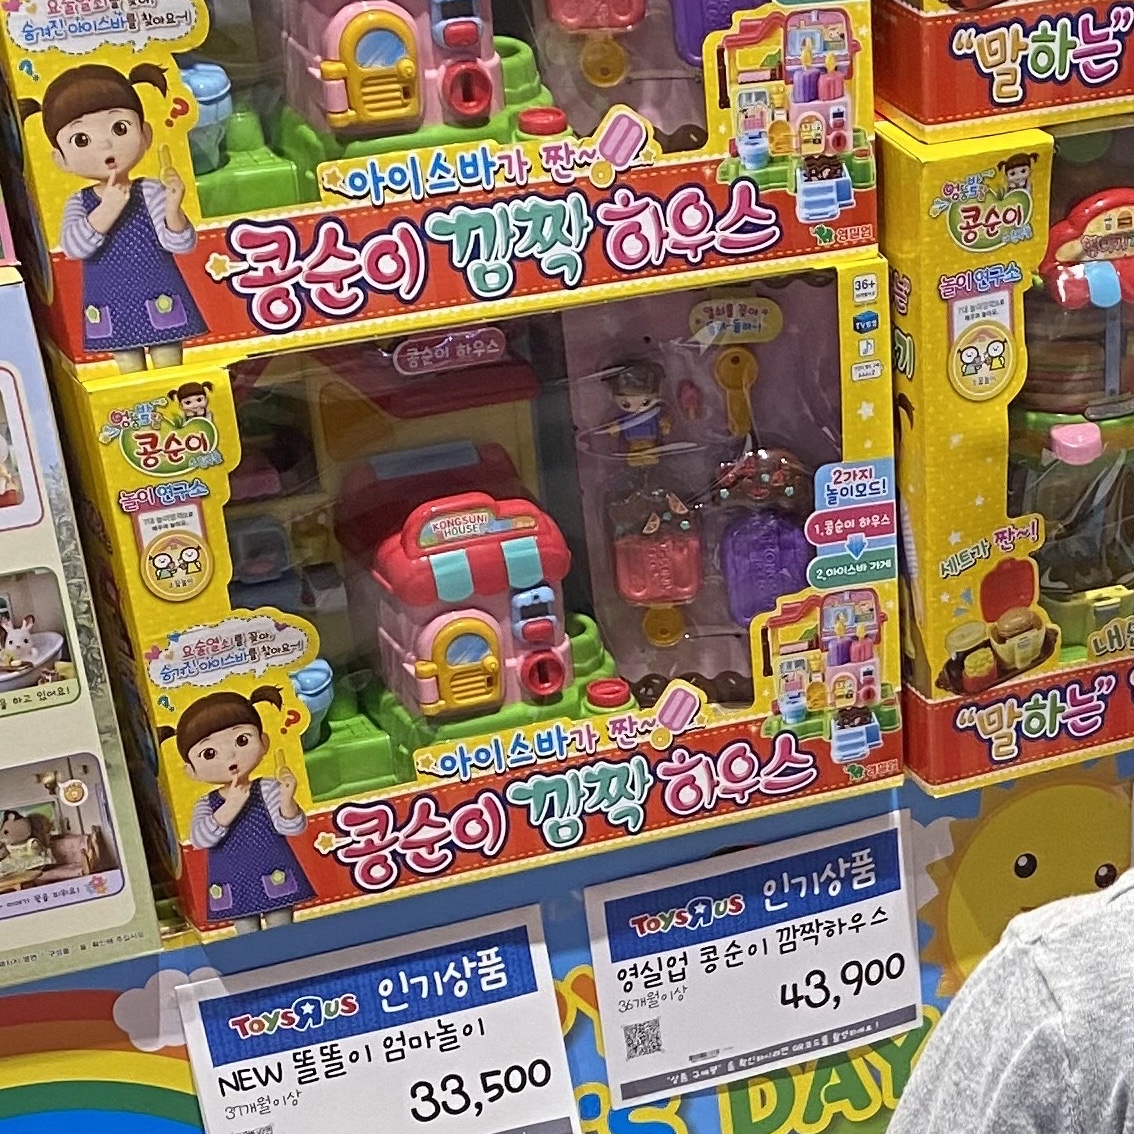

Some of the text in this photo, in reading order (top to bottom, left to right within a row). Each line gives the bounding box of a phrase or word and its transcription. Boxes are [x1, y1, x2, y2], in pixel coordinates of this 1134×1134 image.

[348, 145, 529, 206] 아이스바가
[959, 204, 1024, 245] 콩순이
[229, 179, 779, 331] 콩순이 깜짝 하우스
[854, 279, 875, 291] 36+
[939, 269, 973, 299] 놀이
[973, 259, 1022, 292] 연구소
[456, 339, 501, 359] 하우스
[133, 431, 210, 469] 콩순이
[118, 479, 210, 512] 놀이 연구소
[825, 479, 887, 506] 놀이모드!
[832, 467, 873, 486] 2가지
[431, 511, 489, 532] KONGSUNI
[443, 524, 479, 540] HOUSE
[858, 513, 891, 529] 하우스
[869, 558, 892, 570] 가게
[438, 724, 598, 780] 아이스바가
[335, 733, 817, 890] 콩순이 깜짝 하우스
[762, 848, 876, 913] 인기상품
[616, 906, 889, 994] 영실업 콩순이 깜짝하우스
[377, 947, 508, 1013] 인기상품
[618, 985, 689, 1013] 36개월이상
[780, 952, 906, 1010] 43,900
[217, 1061, 283, 1097] NEW
[383, 1018, 486, 1063] 엄마놀이
[224, 1089, 302, 1121] 37개월이상
[409, 1058, 552, 1123] 33,500
